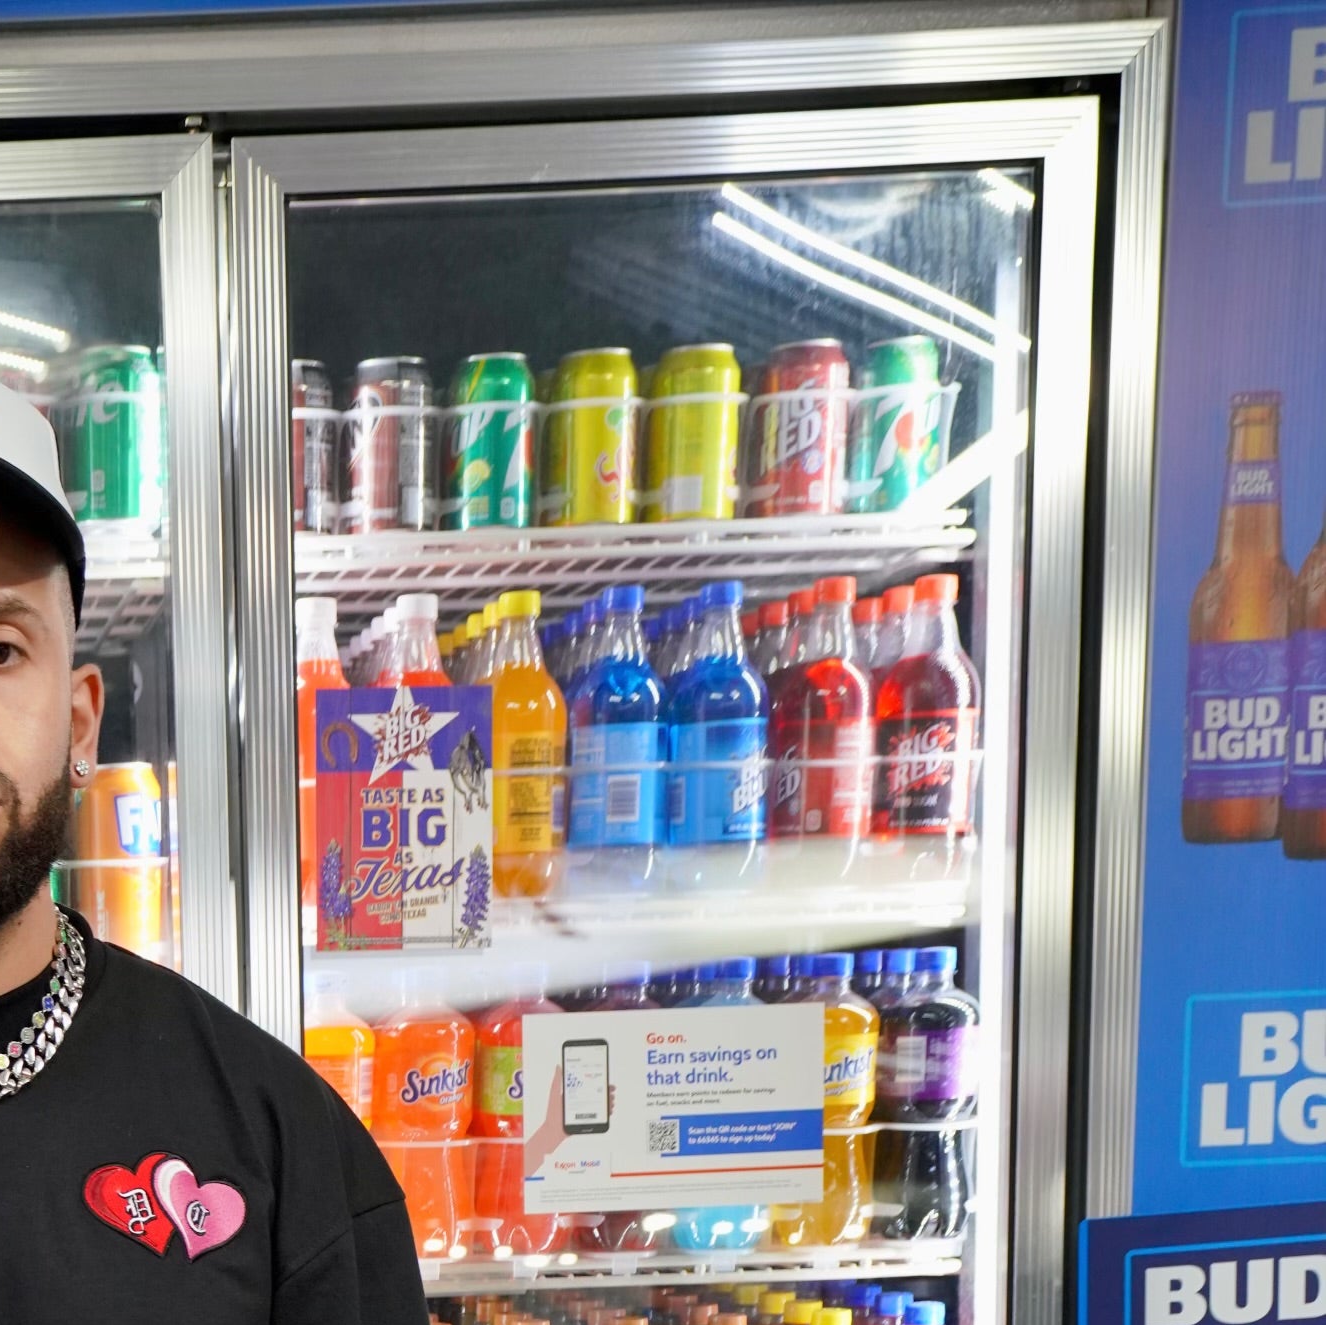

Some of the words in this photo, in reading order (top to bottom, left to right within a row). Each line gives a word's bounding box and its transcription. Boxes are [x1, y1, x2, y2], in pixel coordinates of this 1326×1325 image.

[1231, 481, 1274, 497] LIGHT
[1237, 471, 1269, 485] BUD
[386, 704, 422, 736] BIG
[1204, 697, 1280, 730] BUD
[383, 727, 426, 758] RED
[1192, 725, 1287, 762] LIGHT
[362, 788, 417, 804] TASTE
[422, 788, 444, 803] AS
[362, 808, 447, 849] BIG
[394, 851, 413, 864] AS
[345, 856, 465, 902] Texas
[647, 1033, 664, 1045] Go
[667, 1034, 687, 1044] on.
[647, 1049, 684, 1065] Earn
[690, 1047, 751, 1069] savings
[757, 1047, 777, 1060] on
[824, 1047, 875, 1085] unkist
[402, 1061, 471, 1103] Sunkist
[647, 1069, 682, 1086] that
[686, 1067, 733, 1084] drink.
[1199, 1077, 1326, 1148] LIG
[688, 1127, 705, 1135] Scan
[706, 1126, 717, 1134] the
